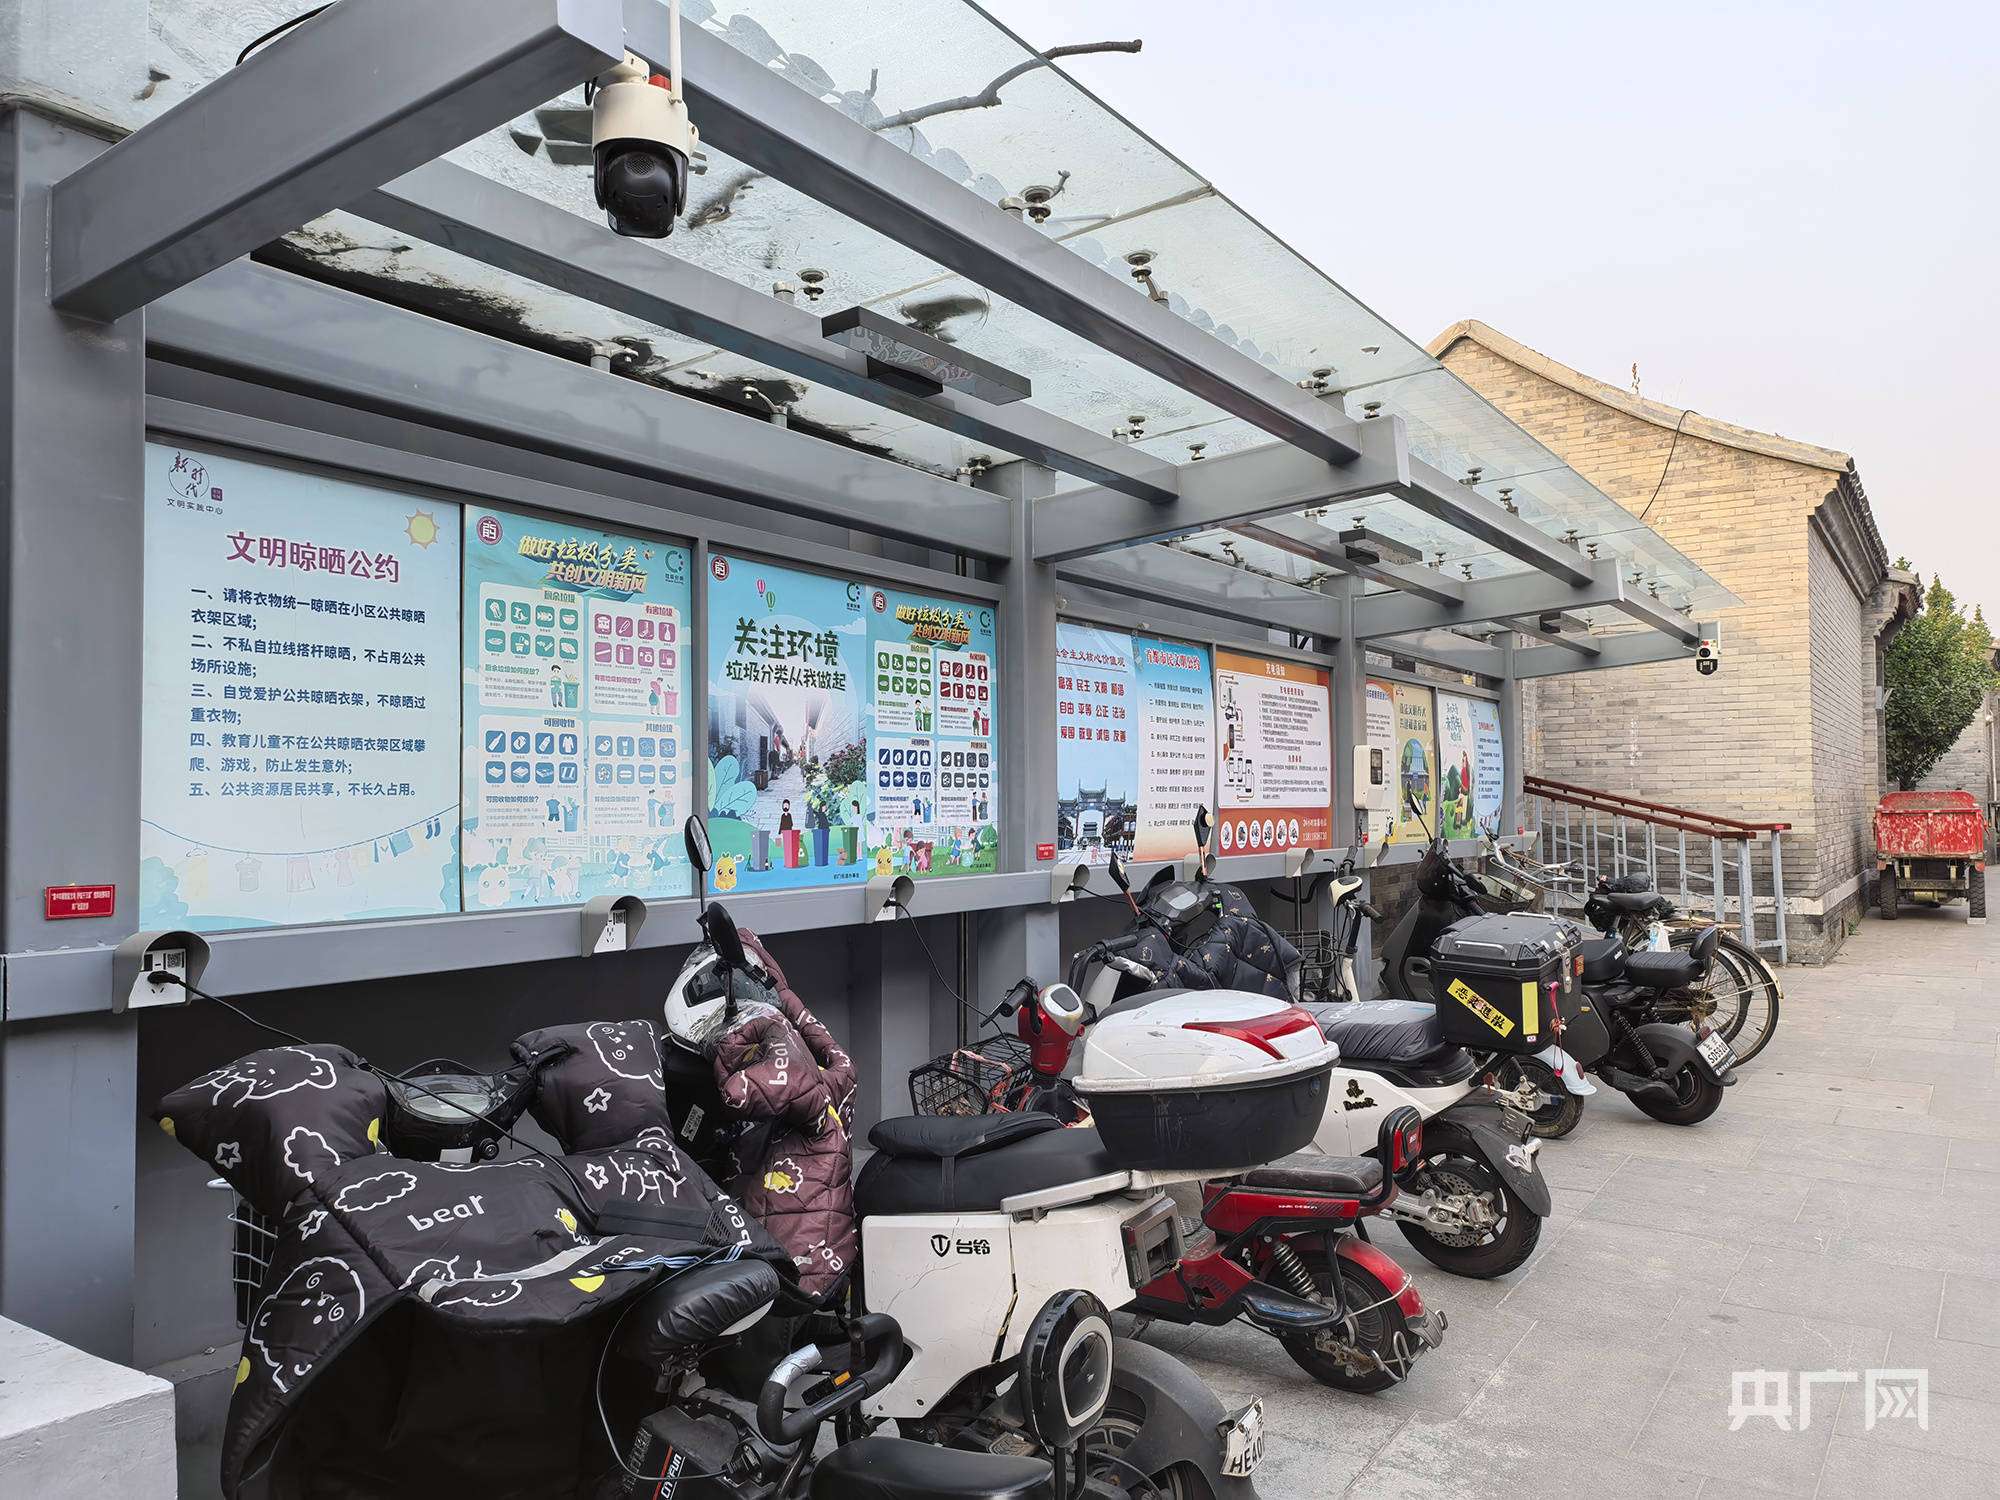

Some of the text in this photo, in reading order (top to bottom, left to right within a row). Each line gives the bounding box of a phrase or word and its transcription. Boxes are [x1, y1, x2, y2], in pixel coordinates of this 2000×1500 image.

[167, 498, 223, 515] 文明实践中心
[226, 530, 400, 584] 文明晾晒公约
[518, 535, 640, 571] 做好垃圾分类
[545, 561, 648, 593] 共创文明新风
[190, 587, 426, 624] 一、请将衣物统一晾晒在小区公共晾晒
[190, 634, 426, 667] 二、不私自拉线搭杆晾晒，不占用公共
[734, 616, 840, 666] 关注环境
[726, 660, 846, 692] 垃圾分类从我做起
[190, 683, 426, 710] 三、自觉爱护公共晾晒衣架，不晾晒过
[190, 732, 426, 753] 四、教育儿童不在公共晾晒衣架区域攀
[189, 781, 419, 798] 五、公共资源居民共享，不长久占用。
[768, 1042, 790, 1086] bear
[407, 1194, 485, 1232] bear
[716, 1191, 753, 1246] bear
[808, 1239, 845, 1273] ear
[955, 1238, 991, 1255] 台铃
